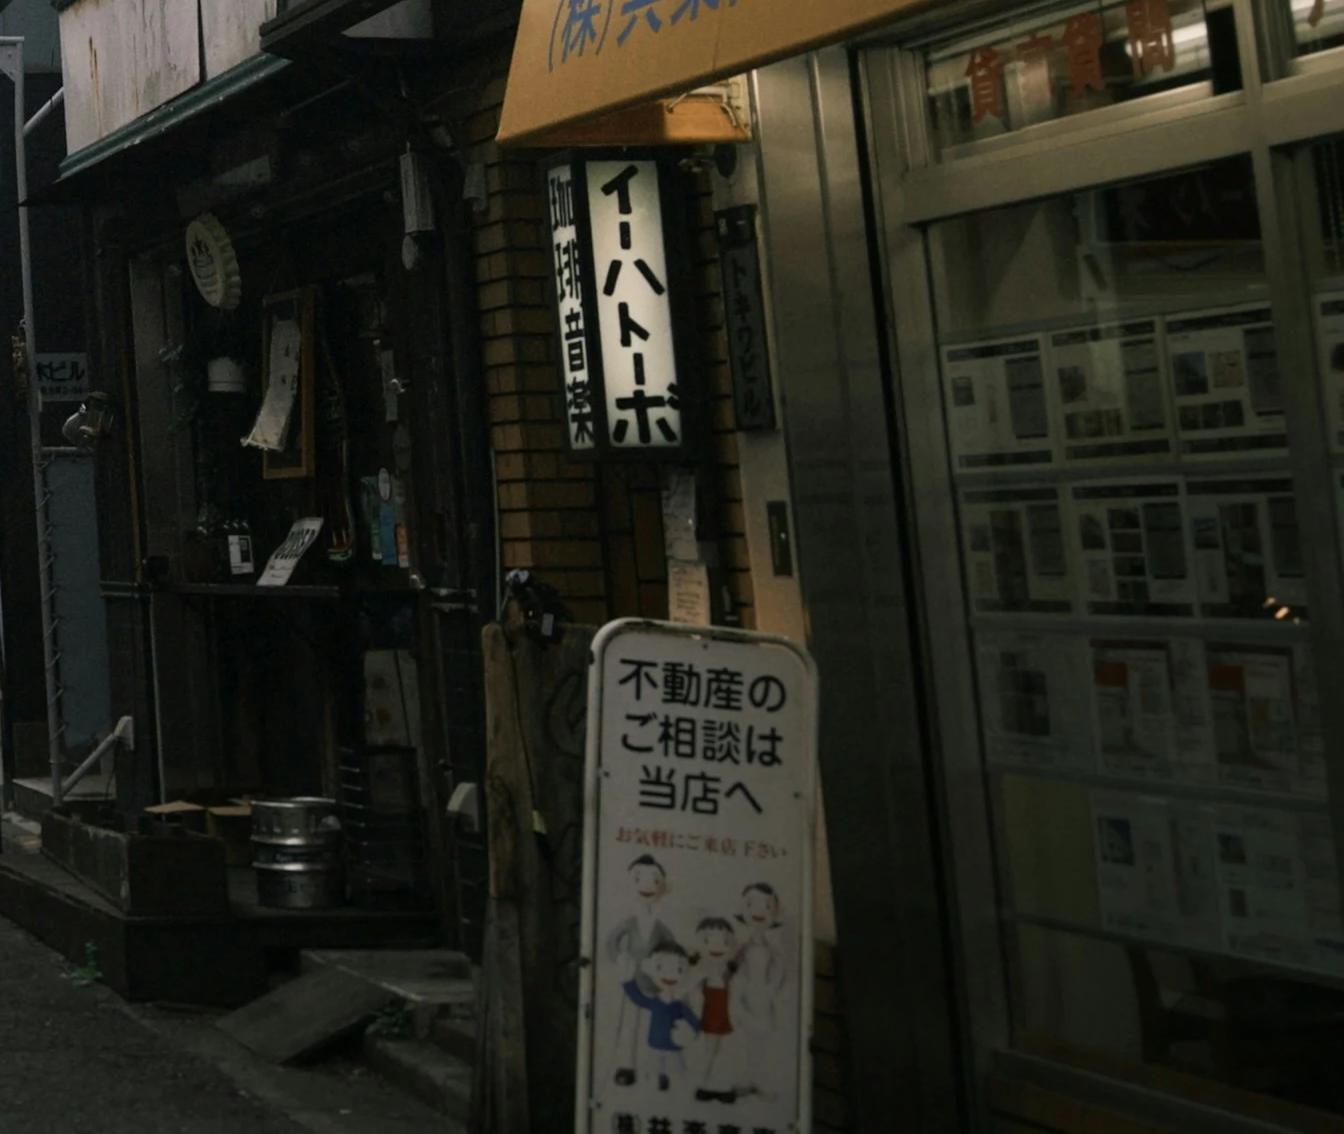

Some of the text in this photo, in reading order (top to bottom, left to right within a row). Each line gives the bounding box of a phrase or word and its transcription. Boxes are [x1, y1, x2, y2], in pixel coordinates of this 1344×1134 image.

[600, 164, 684, 445] イーハトーボ
[617, 656, 787, 715] 不動産の
[621, 713, 784, 768] ご相談は
[638, 766, 764, 816] 当店へ
[615, 826, 789, 861] お気軽にご来店下さい
